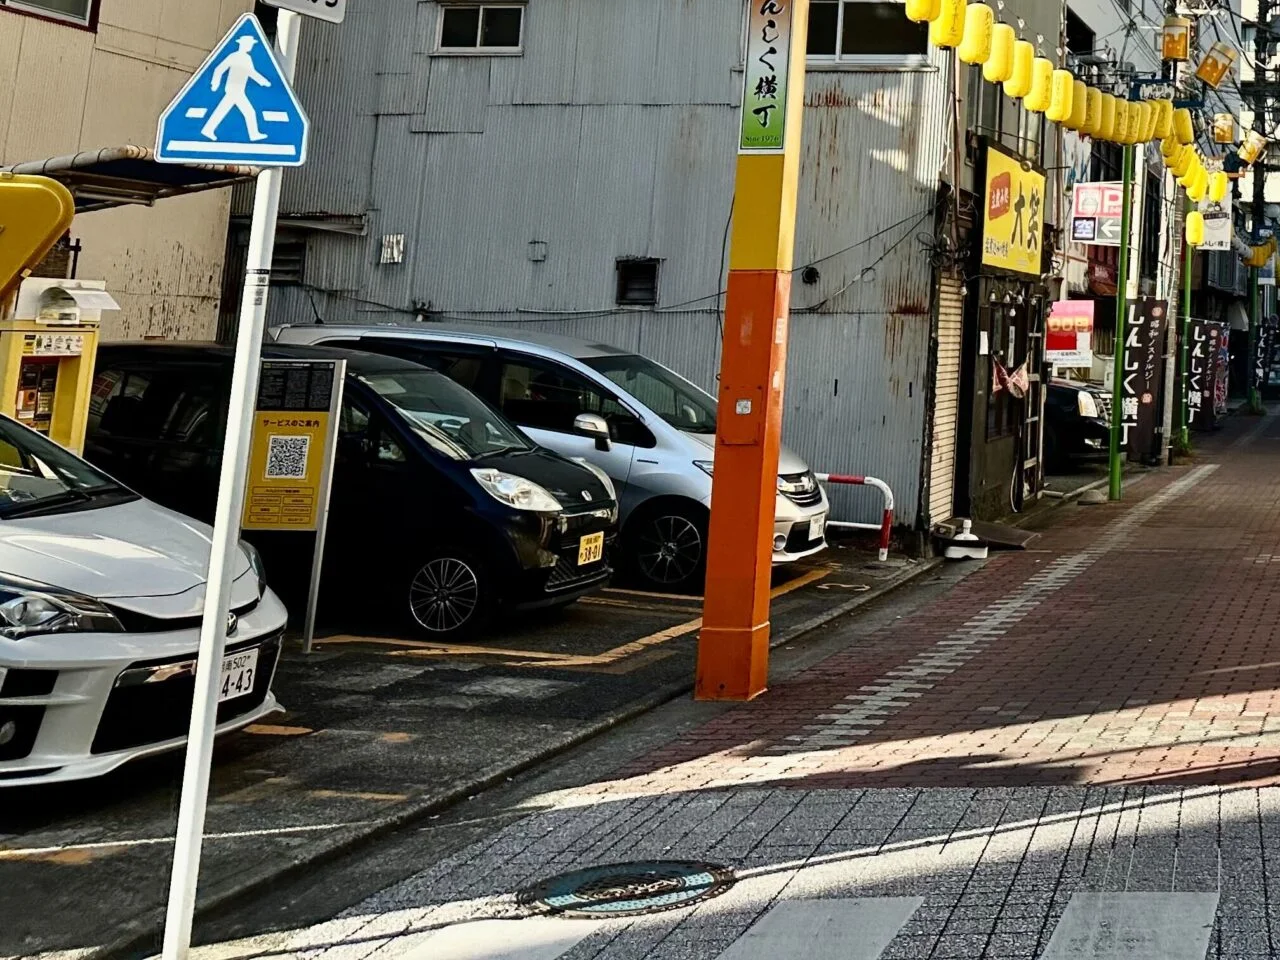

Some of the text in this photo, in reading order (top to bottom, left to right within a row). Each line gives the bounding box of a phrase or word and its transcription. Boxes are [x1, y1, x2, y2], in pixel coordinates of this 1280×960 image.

[1120, 304, 1145, 445] しんしく横丁
[1187, 325, 1206, 424] しんしく横丁
[263, 419, 320, 428] サービスのご案内
[222, 668, 253, 697] 4-43
